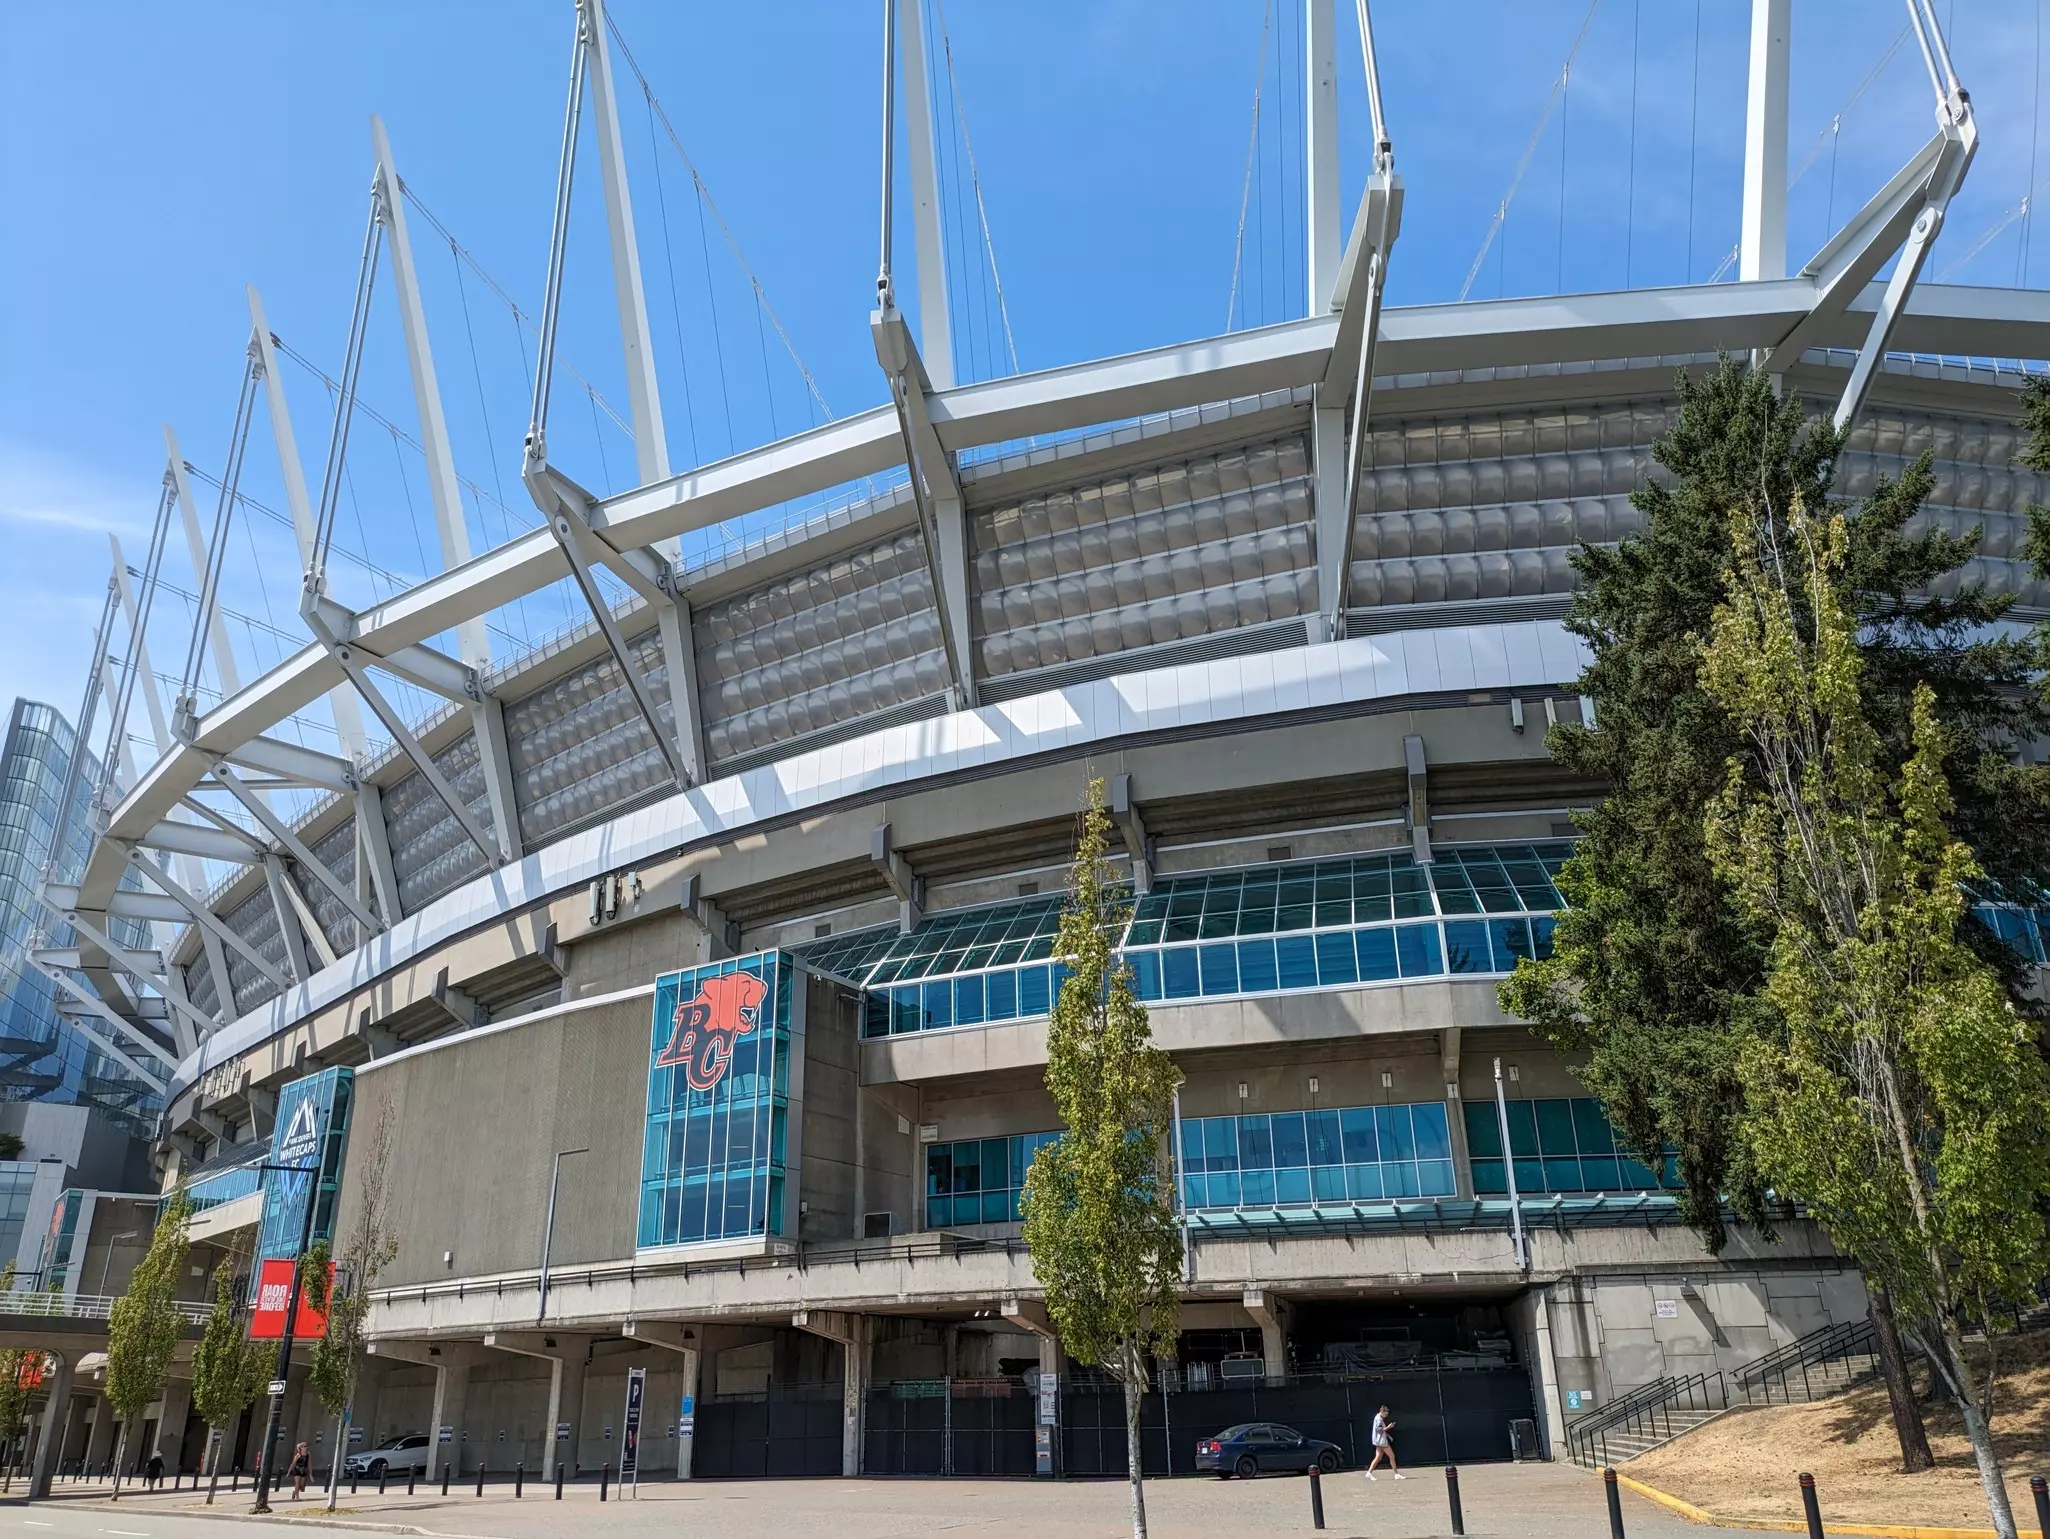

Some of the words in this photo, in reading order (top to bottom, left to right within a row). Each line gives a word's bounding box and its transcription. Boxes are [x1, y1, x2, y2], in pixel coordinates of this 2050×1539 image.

[655, 1001, 735, 1091] BC
[280, 1141, 316, 1161] WHITECAPS
[632, 1384, 640, 1403] P
